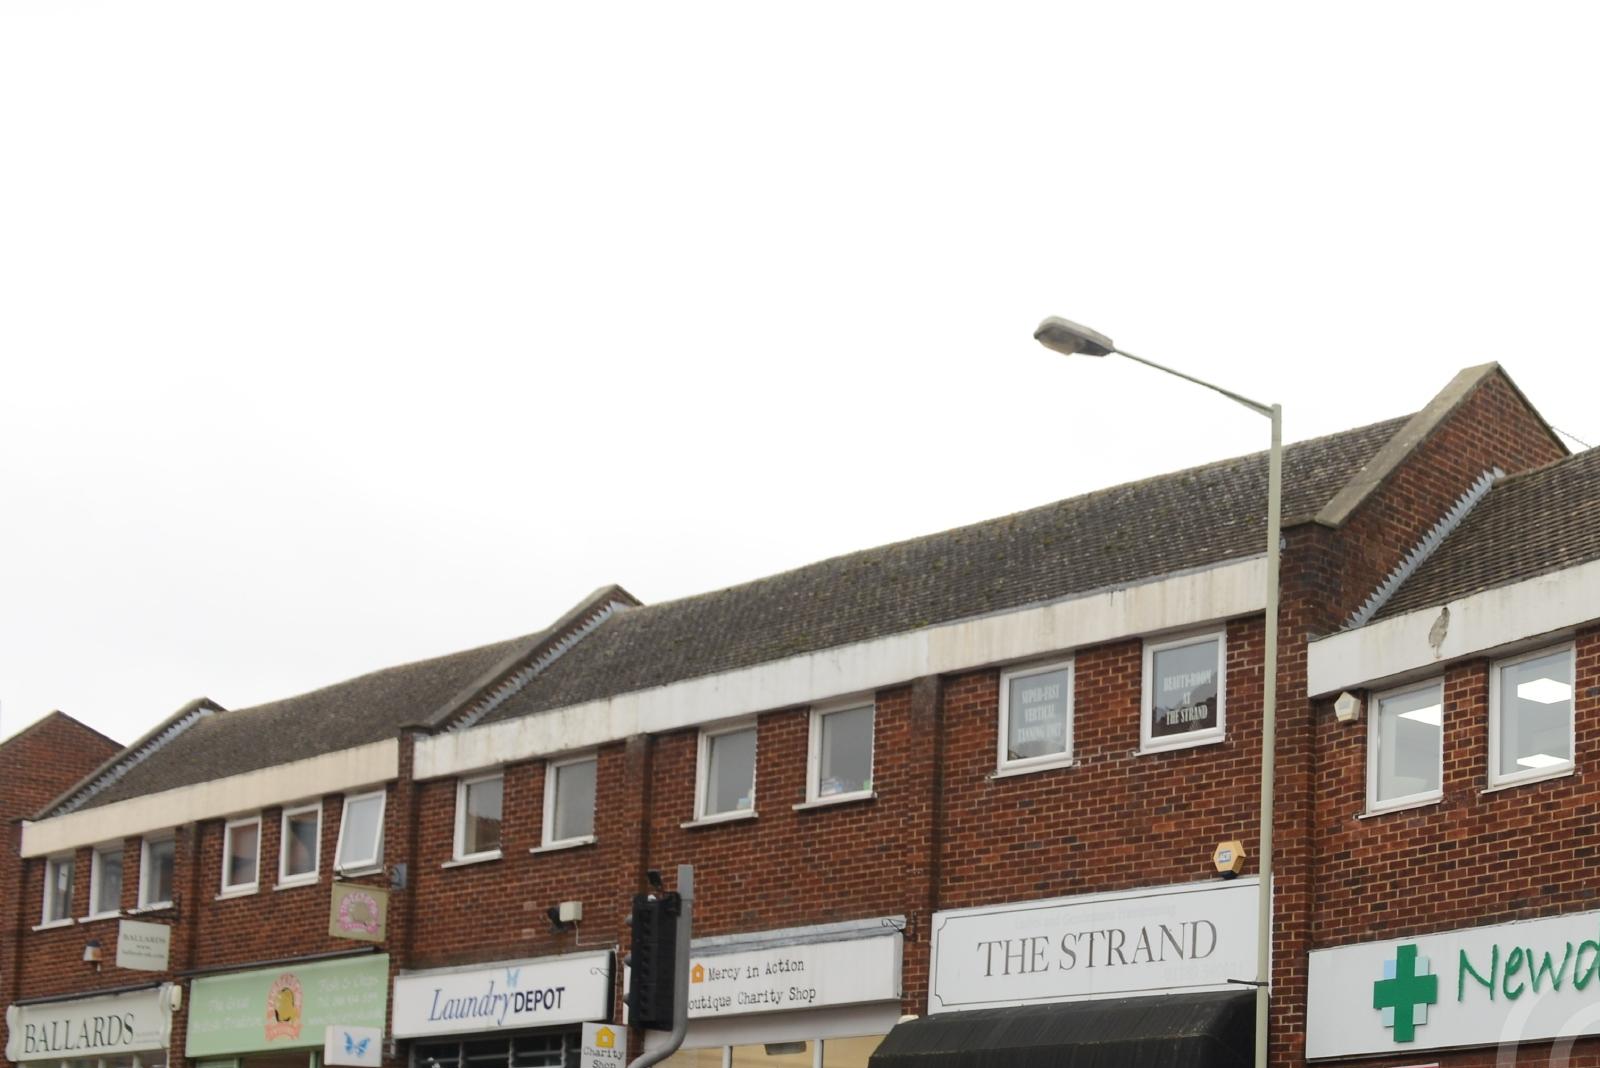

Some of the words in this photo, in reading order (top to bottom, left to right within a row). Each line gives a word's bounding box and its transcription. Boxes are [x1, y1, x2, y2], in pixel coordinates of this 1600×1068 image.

[1166, 710, 1179, 725] THE
[1181, 704, 1208, 723] STRAND
[977, 936, 1050, 977] THE
[1059, 919, 1218, 971] STRAND
[708, 967, 740, 982] Mercy
[746, 965, 759, 979] in
[765, 959, 804, 975] Action
[688, 994, 732, 1011] outique
[737, 990, 784, 1005] Charity
[789, 986, 816, 1003] Shop
[25, 1012, 135, 1054] BALLARDS
[583, 1047, 624, 1061] Charity
